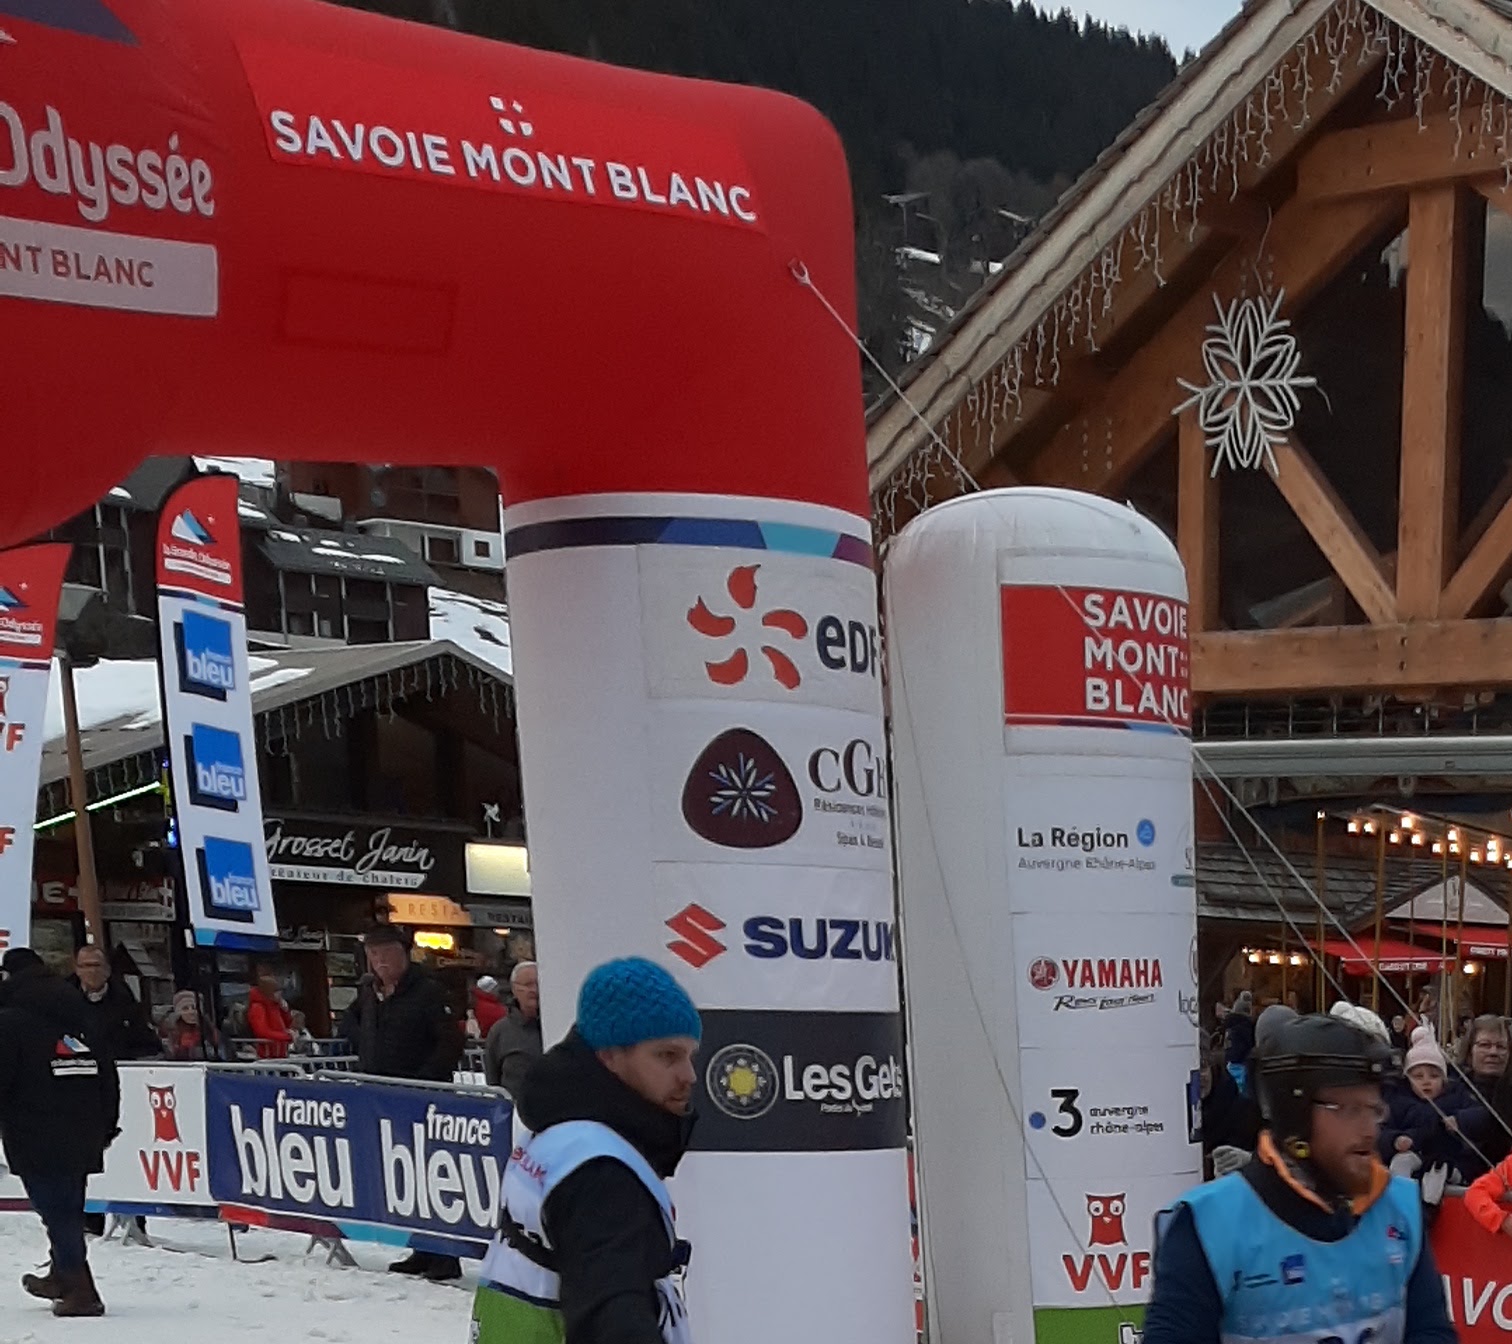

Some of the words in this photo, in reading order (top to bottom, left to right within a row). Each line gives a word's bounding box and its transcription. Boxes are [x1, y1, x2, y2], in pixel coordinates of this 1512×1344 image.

[270, 110, 456, 176] SAVOIE
[462, 140, 596, 196] MONT
[606, 162, 757, 223] BLANC
[0, 242, 42, 274] NT
[52, 249, 154, 287] BLANC
[1084, 593, 1187, 640] SAVOIE
[187, 647, 234, 687] bleu
[1084, 635, 1179, 678] MONT
[1085, 676, 1189, 720] BLANC
[198, 762, 244, 798] bleu
[1017, 826, 1044, 848] La
[1050, 823, 1129, 853] Région
[1061, 958, 1163, 988] YAMAHA
[784, 1055, 852, 1101] Les
[276, 1089, 347, 1129] france
[426, 1103, 492, 1147] france
[1050, 1089, 1083, 1138] 3
[139, 1149, 200, 1192] VVF
[230, 1104, 355, 1208] bleu
[380, 1118, 500, 1229] bleu
[1062, 1252, 1151, 1292] VVF
